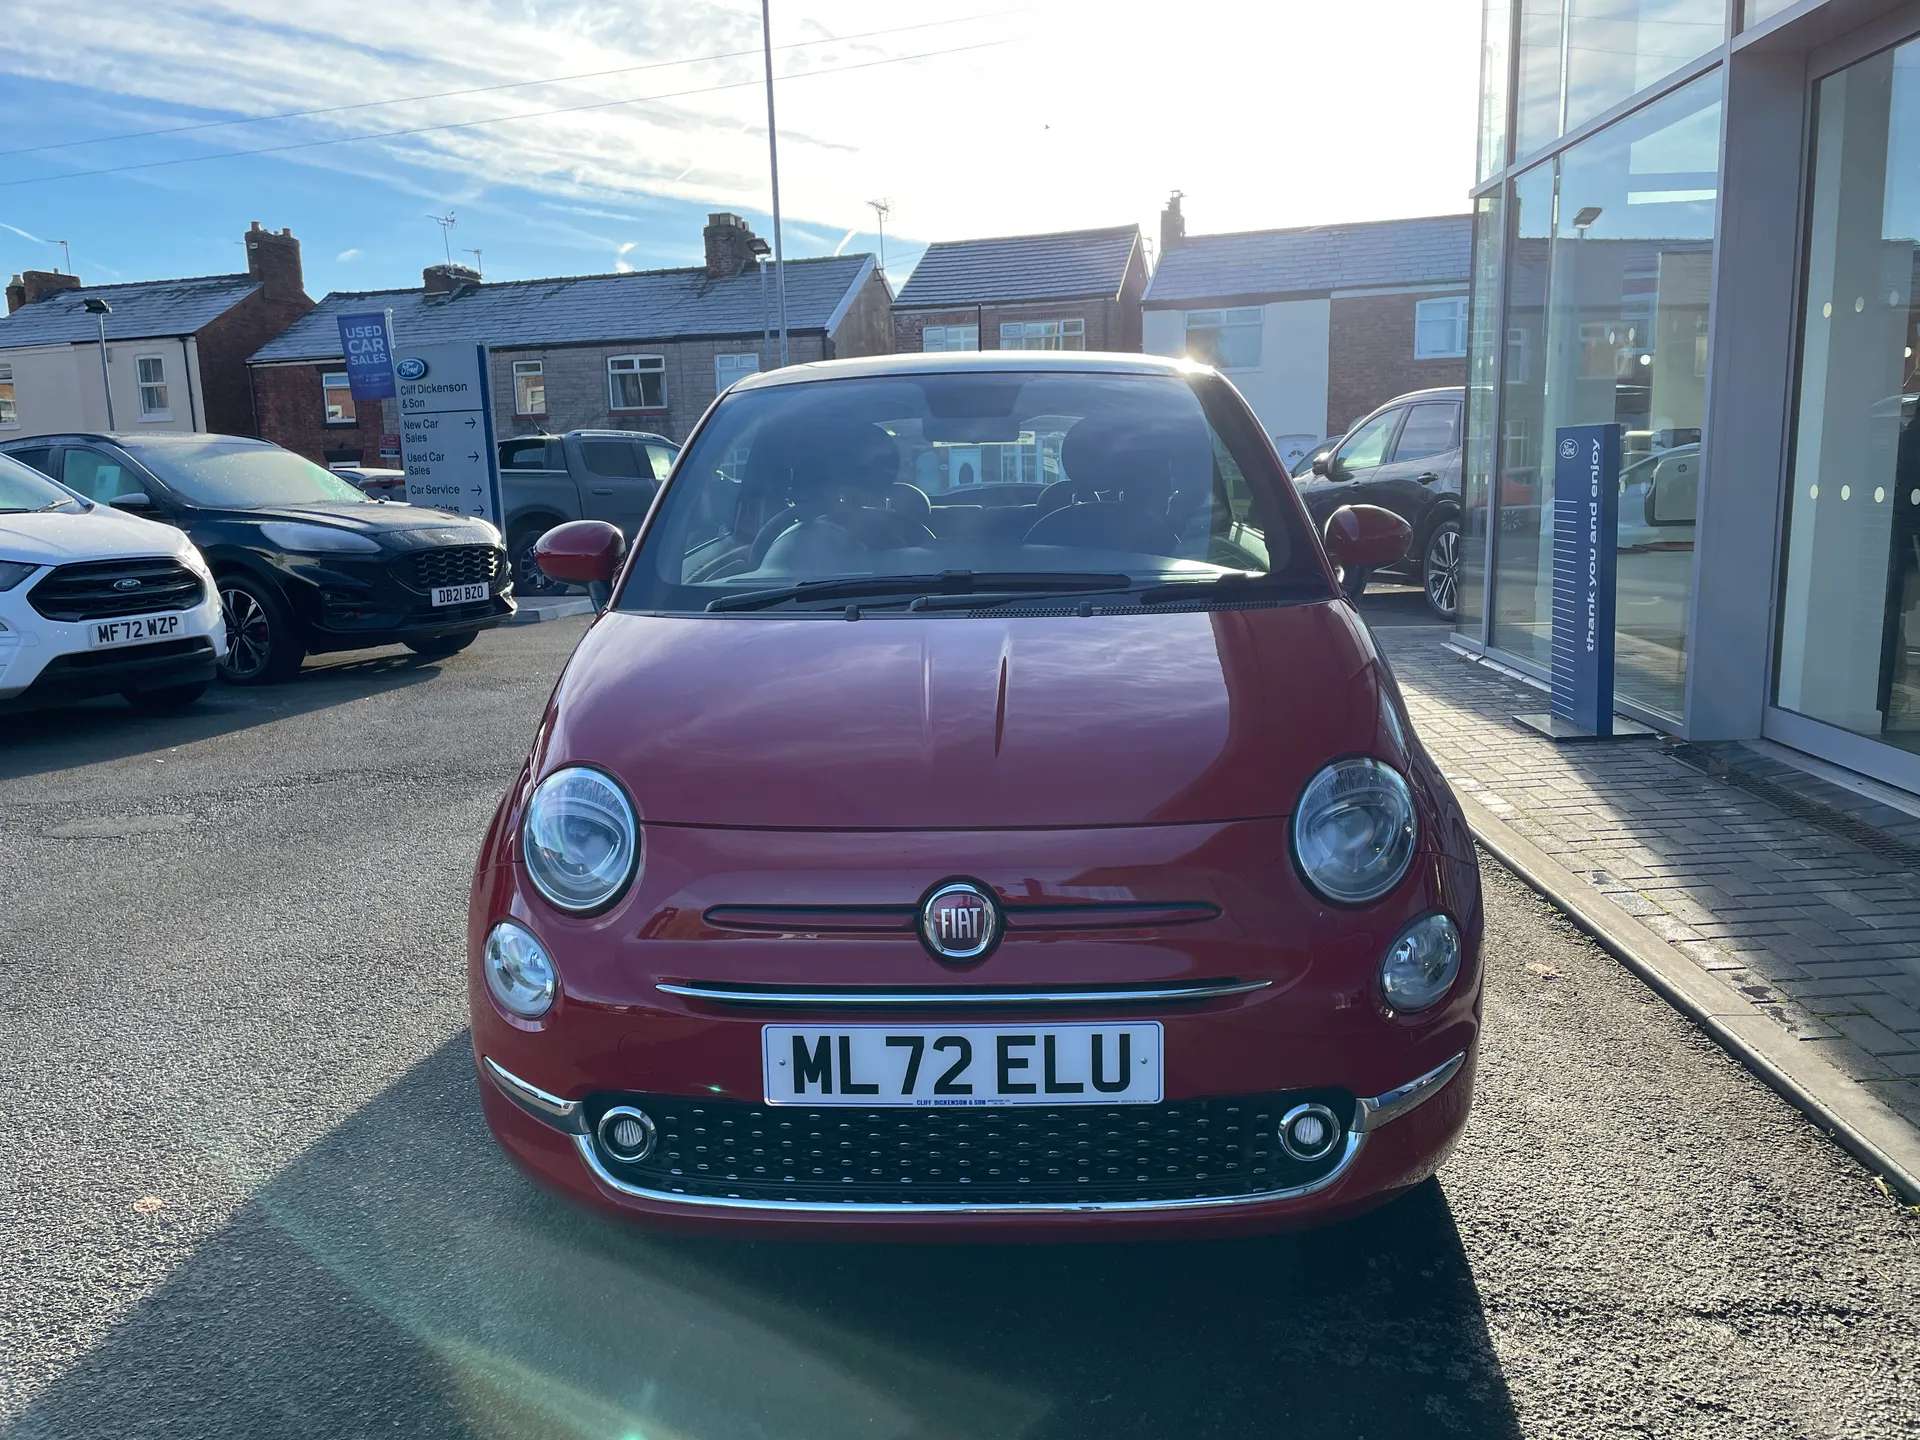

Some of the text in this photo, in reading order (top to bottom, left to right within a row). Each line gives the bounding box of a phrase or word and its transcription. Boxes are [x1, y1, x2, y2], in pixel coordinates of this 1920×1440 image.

[345, 325, 382, 338] USED
[348, 338, 384, 354] CAR
[350, 353, 387, 365] SALES
[400, 383, 468, 395] Cliff Dickenson
[402, 398, 425, 409] & Son
[404, 418, 439, 430] New Car
[405, 433, 427, 443] Sales
[407, 452, 445, 463] Used Car
[408, 466, 430, 476] Sales
[410, 484, 460, 495] Car Service
[1587, 438, 1600, 652] thank you and enjoy
[439, 585, 484, 603] DB21 BZO
[97, 616, 178, 643] MF72 WZP
[940, 907, 981, 940] FIAT
[792, 1033, 1131, 1095] ML72 ELU
